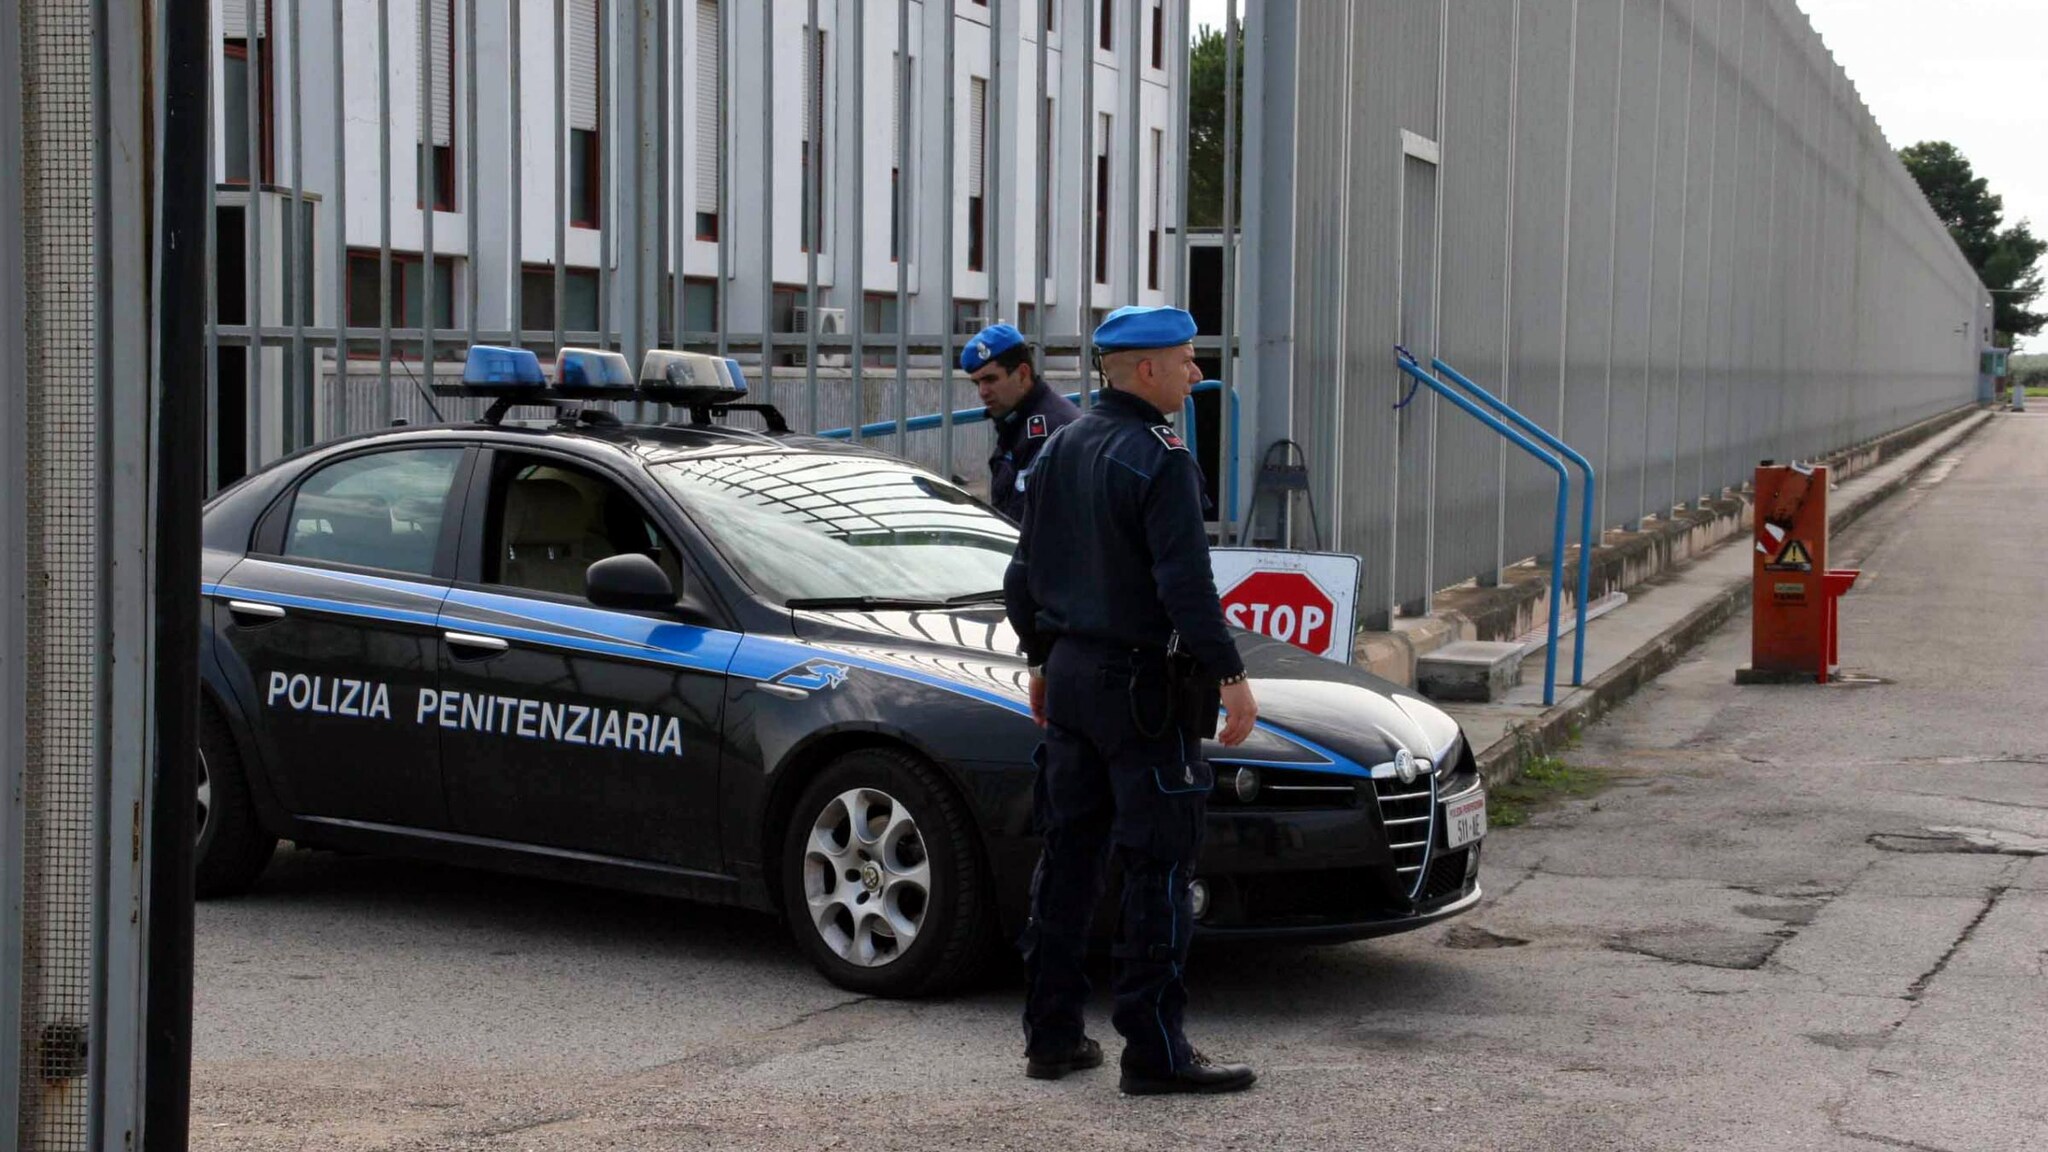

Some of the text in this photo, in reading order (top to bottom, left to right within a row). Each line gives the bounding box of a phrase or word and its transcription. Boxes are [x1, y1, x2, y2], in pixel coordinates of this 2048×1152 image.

[1225, 602, 1325, 645] STOP
[267, 671, 682, 756] POLIZIA PENITENZIARIA
